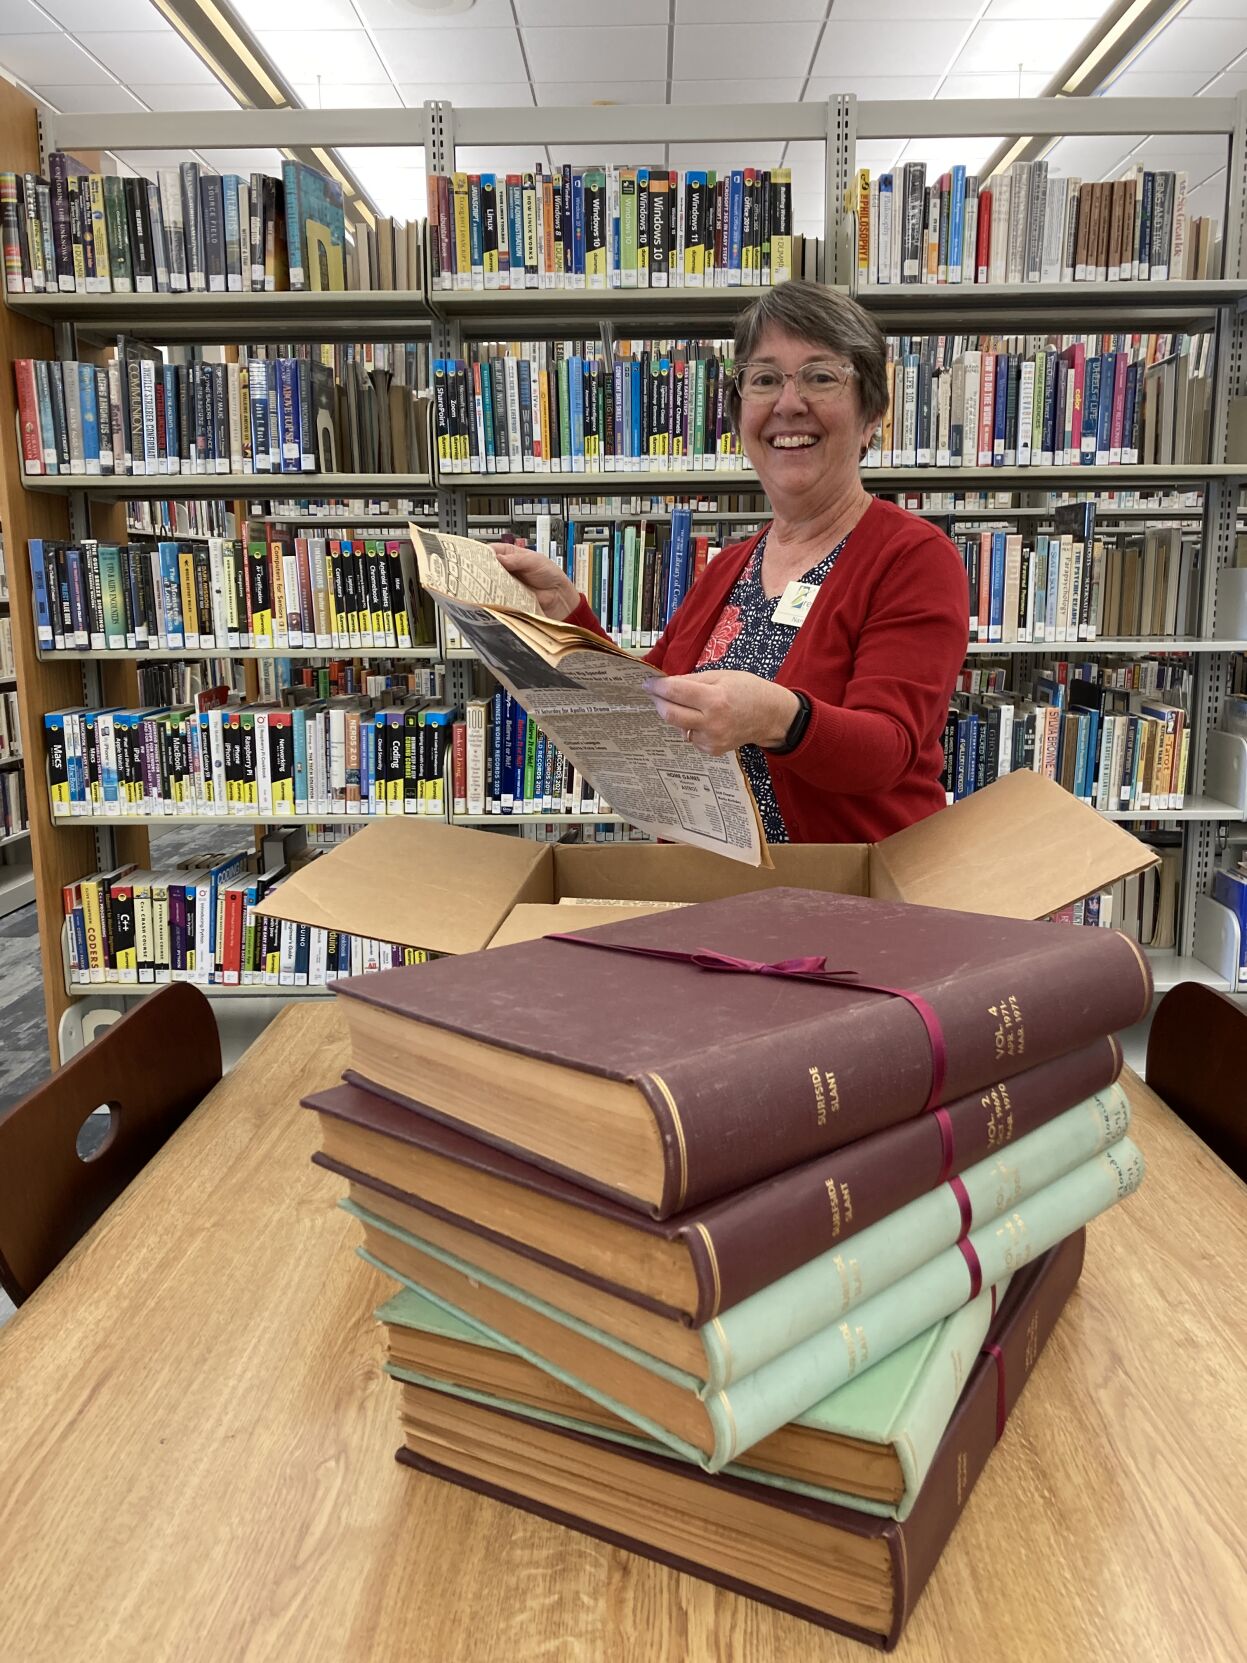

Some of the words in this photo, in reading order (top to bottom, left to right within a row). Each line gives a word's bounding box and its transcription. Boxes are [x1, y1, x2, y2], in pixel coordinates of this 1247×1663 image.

[208, 186, 216, 218] SOURCE
[691, 193, 699, 230] Windows
[514, 205, 522, 256] ADMINISTRATION
[654, 197, 663, 244] Windows
[859, 200, 868, 256] PHILOSOPHY
[593, 238, 600, 247] 10
[626, 236, 632, 244] 10
[640, 234, 647, 243] 10
[692, 234, 698, 242] 11
[1173, 242, 1182, 257] Ide
[654, 248, 662, 260] 10
[906, 370, 914, 390] LIFE
[99, 398, 108, 422] AMONG
[128, 364, 143, 434] COMMUNION
[436, 387, 445, 426] SharePoint
[101, 424, 109, 433] US
[274, 545, 282, 581] Computers
[673, 552, 683, 578] Library
[369, 565, 378, 603] Chromebook
[1060, 557, 1070, 615] Parapsychology
[171, 584, 180, 625] Monsters
[671, 589, 681, 616] Congre
[1048, 712, 1058, 735] SYLVIA
[53, 744, 62, 769] Macs
[173, 737, 182, 771] MacBook
[244, 736, 252, 768] Raspberry
[391, 741, 400, 768] Coding
[1046, 737, 1056, 769] BROWNE
[1163, 741, 1172, 771] Tarot
[121, 914, 130, 932] C++
[87, 927, 97, 969] CODERS
[988, 1006, 998, 1016] 4
[1008, 995, 1022, 1022] 1972
[995, 1024, 1005, 1059] VOL.
[809, 1066, 827, 1126] SURFSIDE
[825, 1071, 840, 1113] SLANT
[981, 1095, 991, 1107] 2
[999, 1083, 1011, 1110] 1970
[824, 1177, 841, 1238] SURFSIDE
[840, 1182, 853, 1224] SLANT
